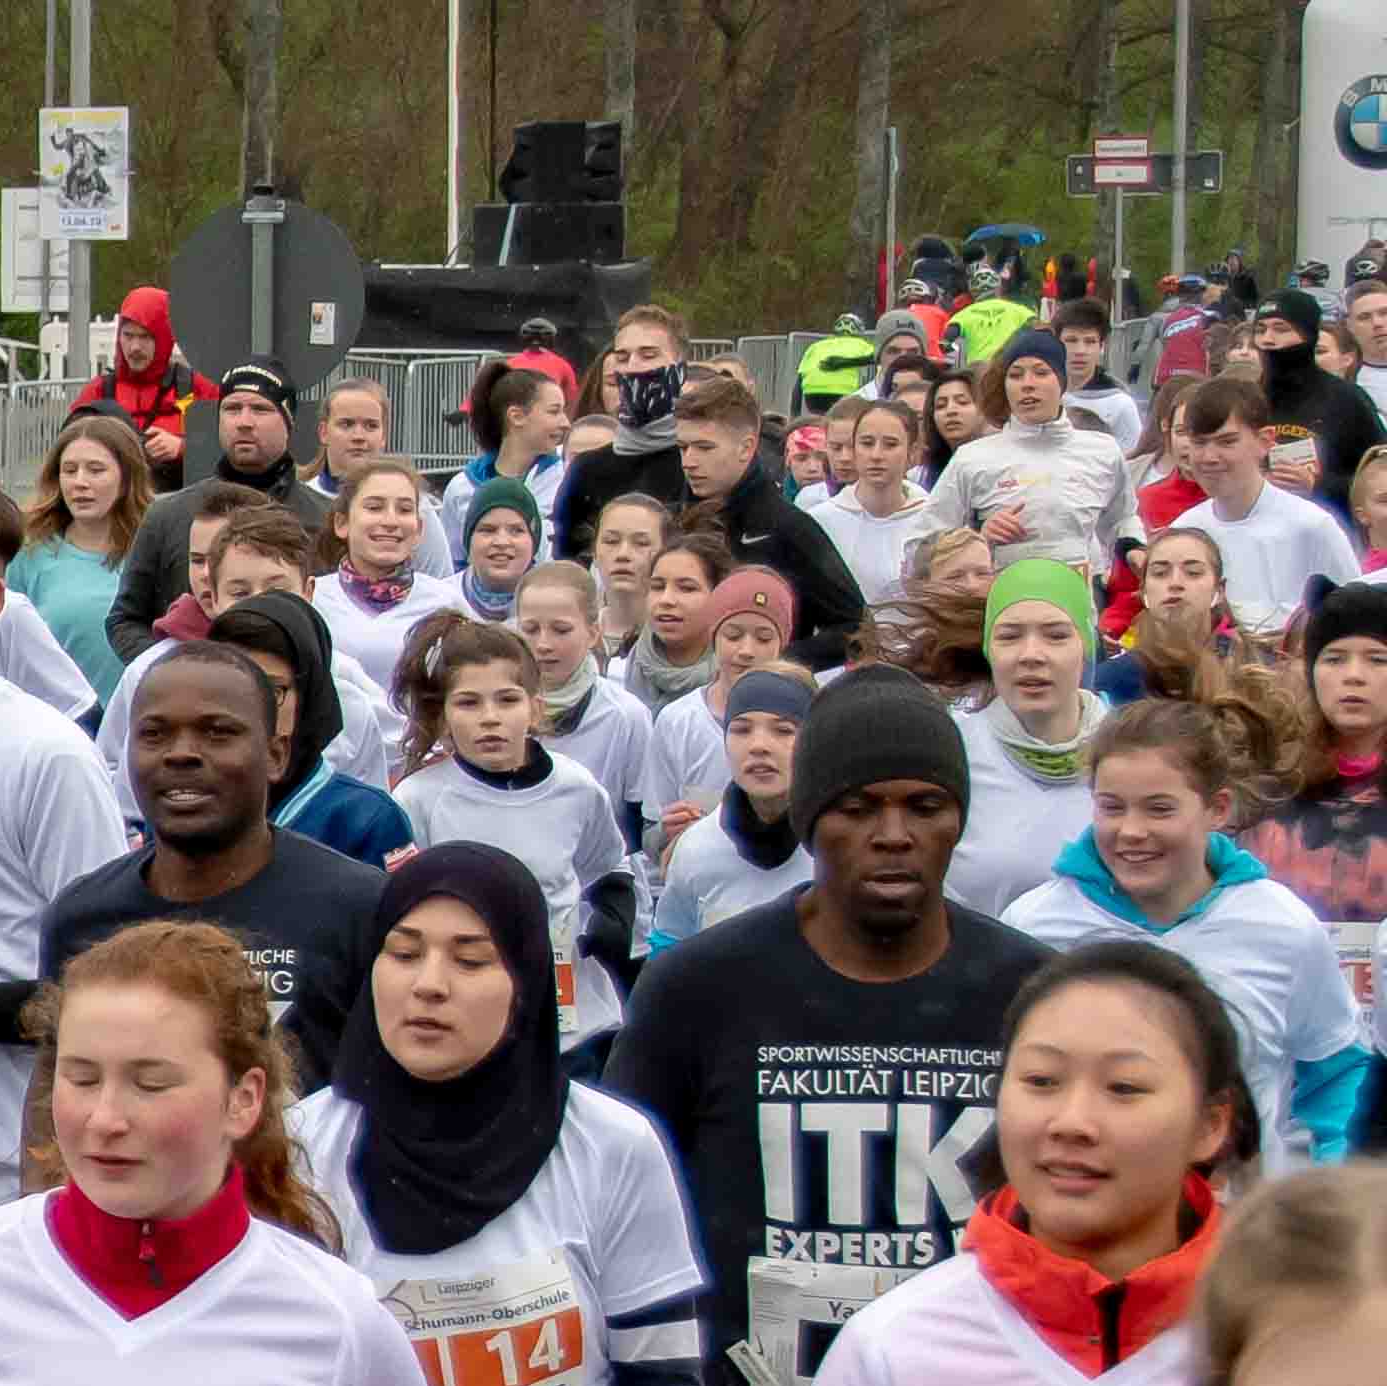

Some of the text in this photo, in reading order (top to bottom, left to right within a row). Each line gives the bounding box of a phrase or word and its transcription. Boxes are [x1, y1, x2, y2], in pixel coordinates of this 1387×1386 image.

[758, 1064, 892, 1096] FAKULTÄT
[758, 1102, 995, 1225] ITK
[765, 1224, 935, 1265] EXPERTS
[436, 1277, 496, 1296] Leipziger
[485, 1319, 565, 1386] 14
